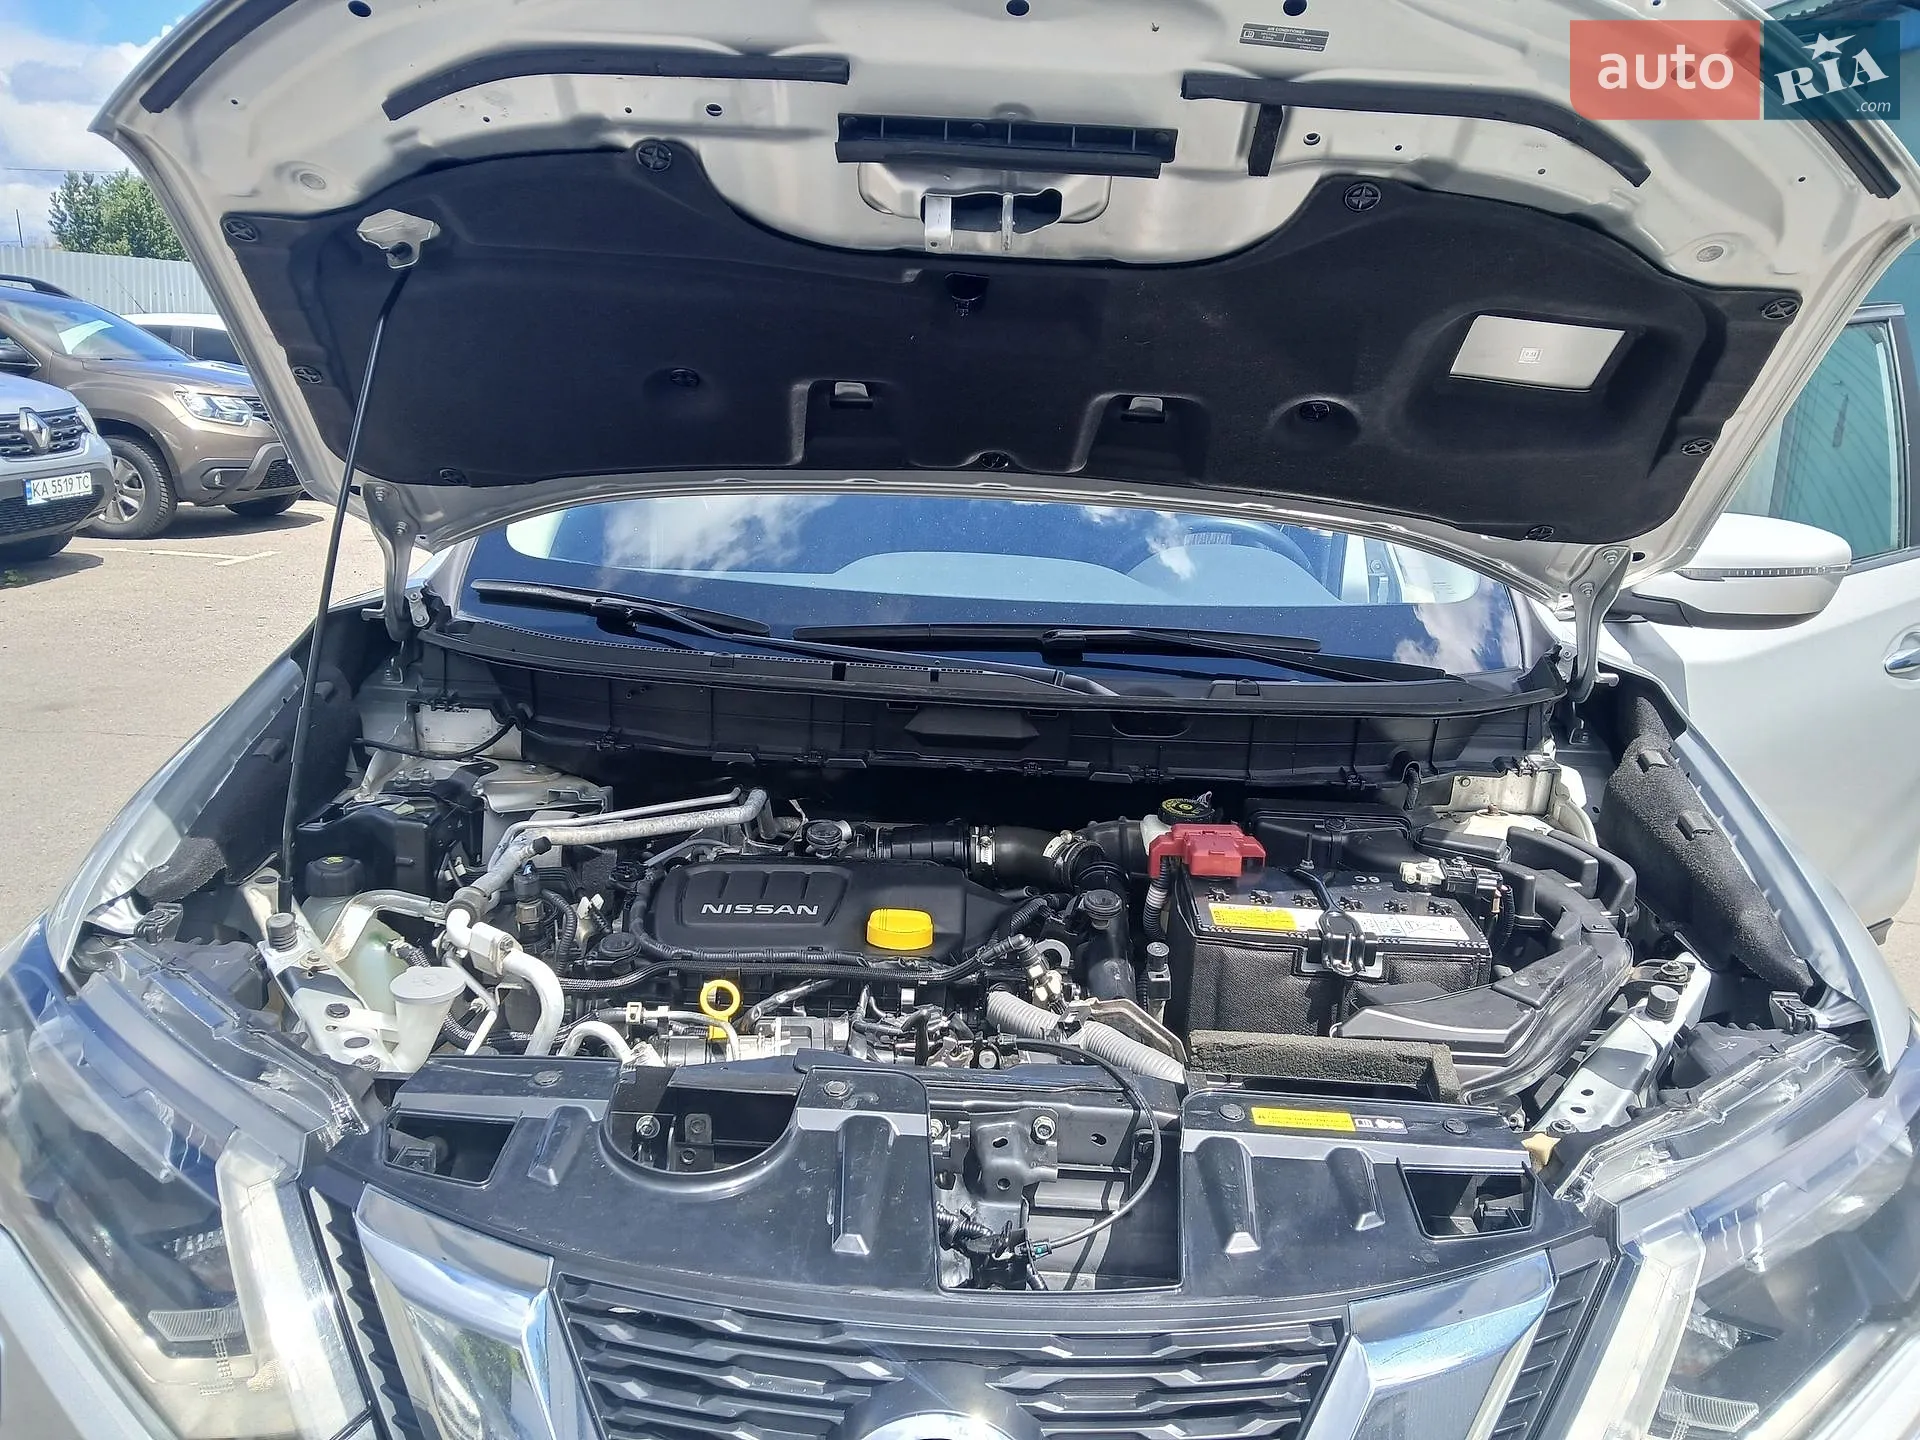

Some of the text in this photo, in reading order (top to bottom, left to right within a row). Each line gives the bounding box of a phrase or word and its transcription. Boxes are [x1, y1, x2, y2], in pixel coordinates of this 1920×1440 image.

[32, 475, 90, 497] KA 5519 TC
[700, 904, 819, 915] NISSAN
